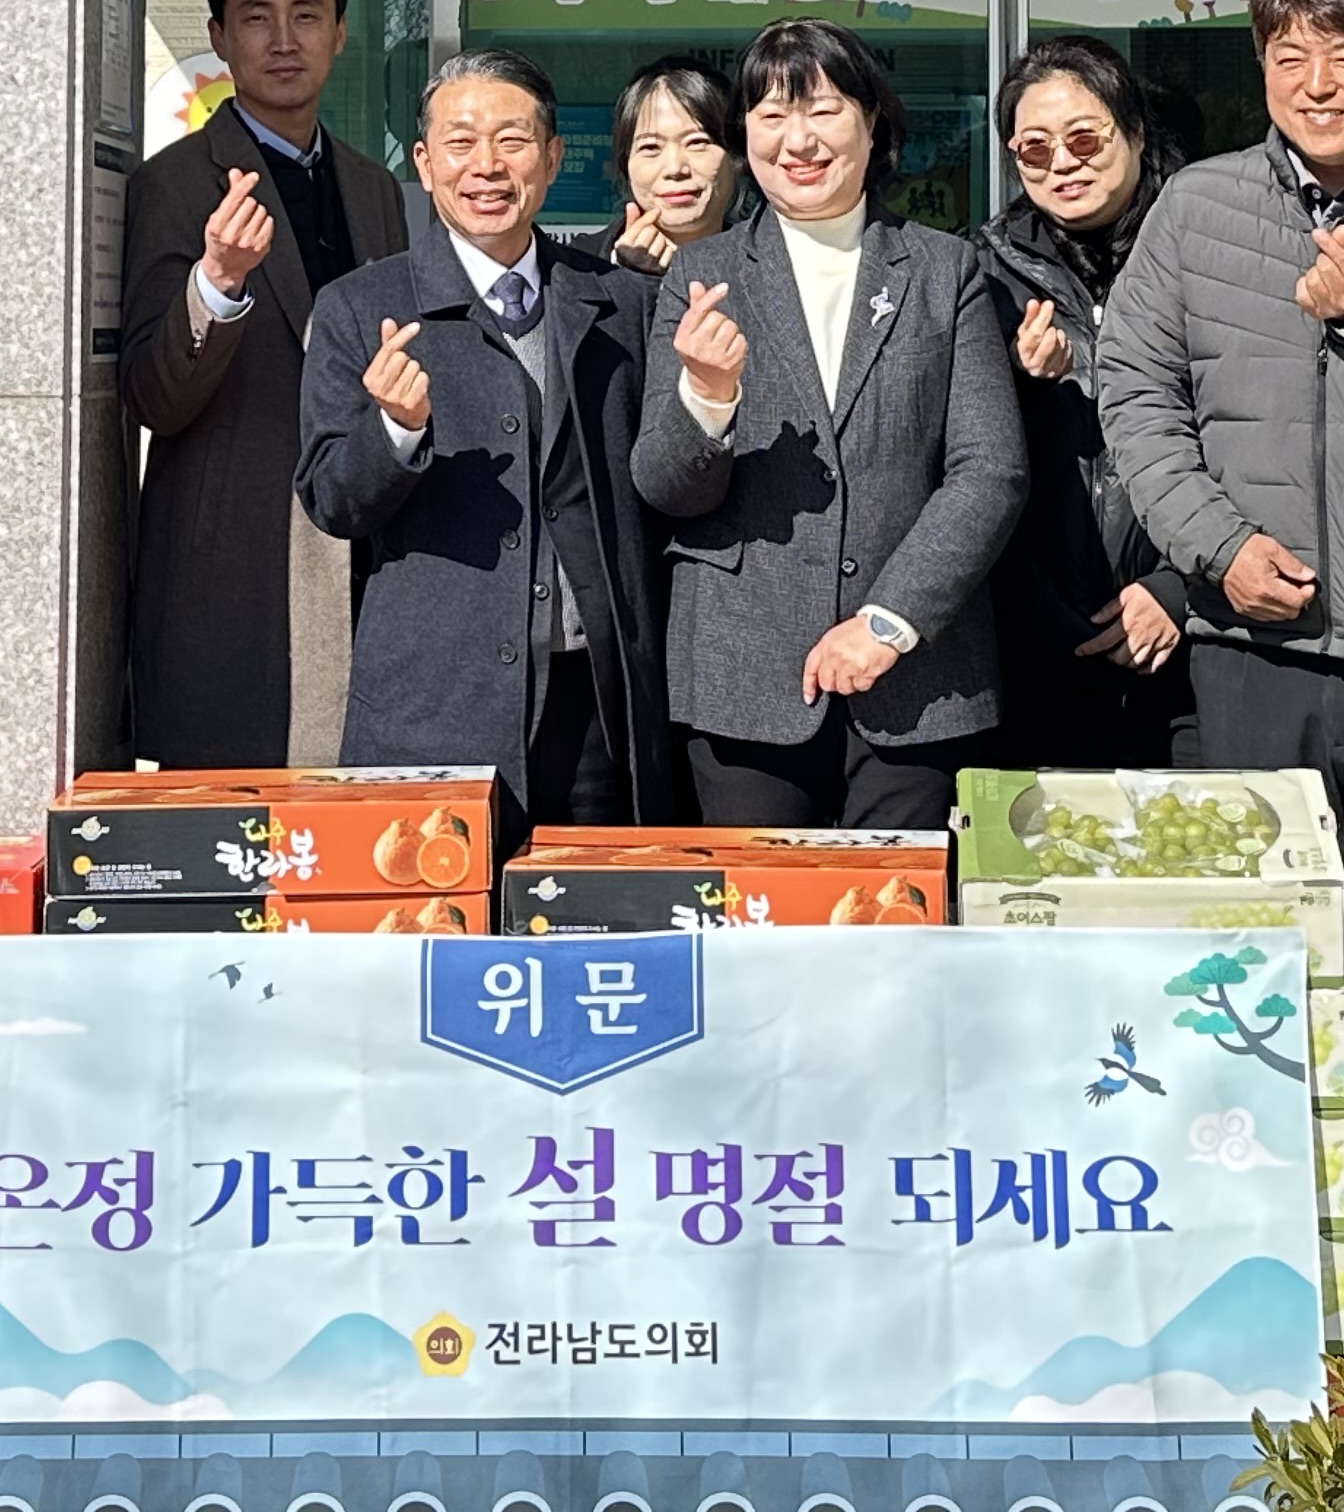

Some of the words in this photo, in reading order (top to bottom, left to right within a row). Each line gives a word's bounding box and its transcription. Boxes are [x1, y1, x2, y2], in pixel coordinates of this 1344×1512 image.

[215, 828, 319, 882] 한라봉
[189, 1144, 486, 1249] 가득한
[507, 1126, 618, 1247] 설
[648, 1143, 847, 1246] 명절
[887, 1146, 1175, 1249] 되세요
[485, 1320, 719, 1365] 전라남도의회
